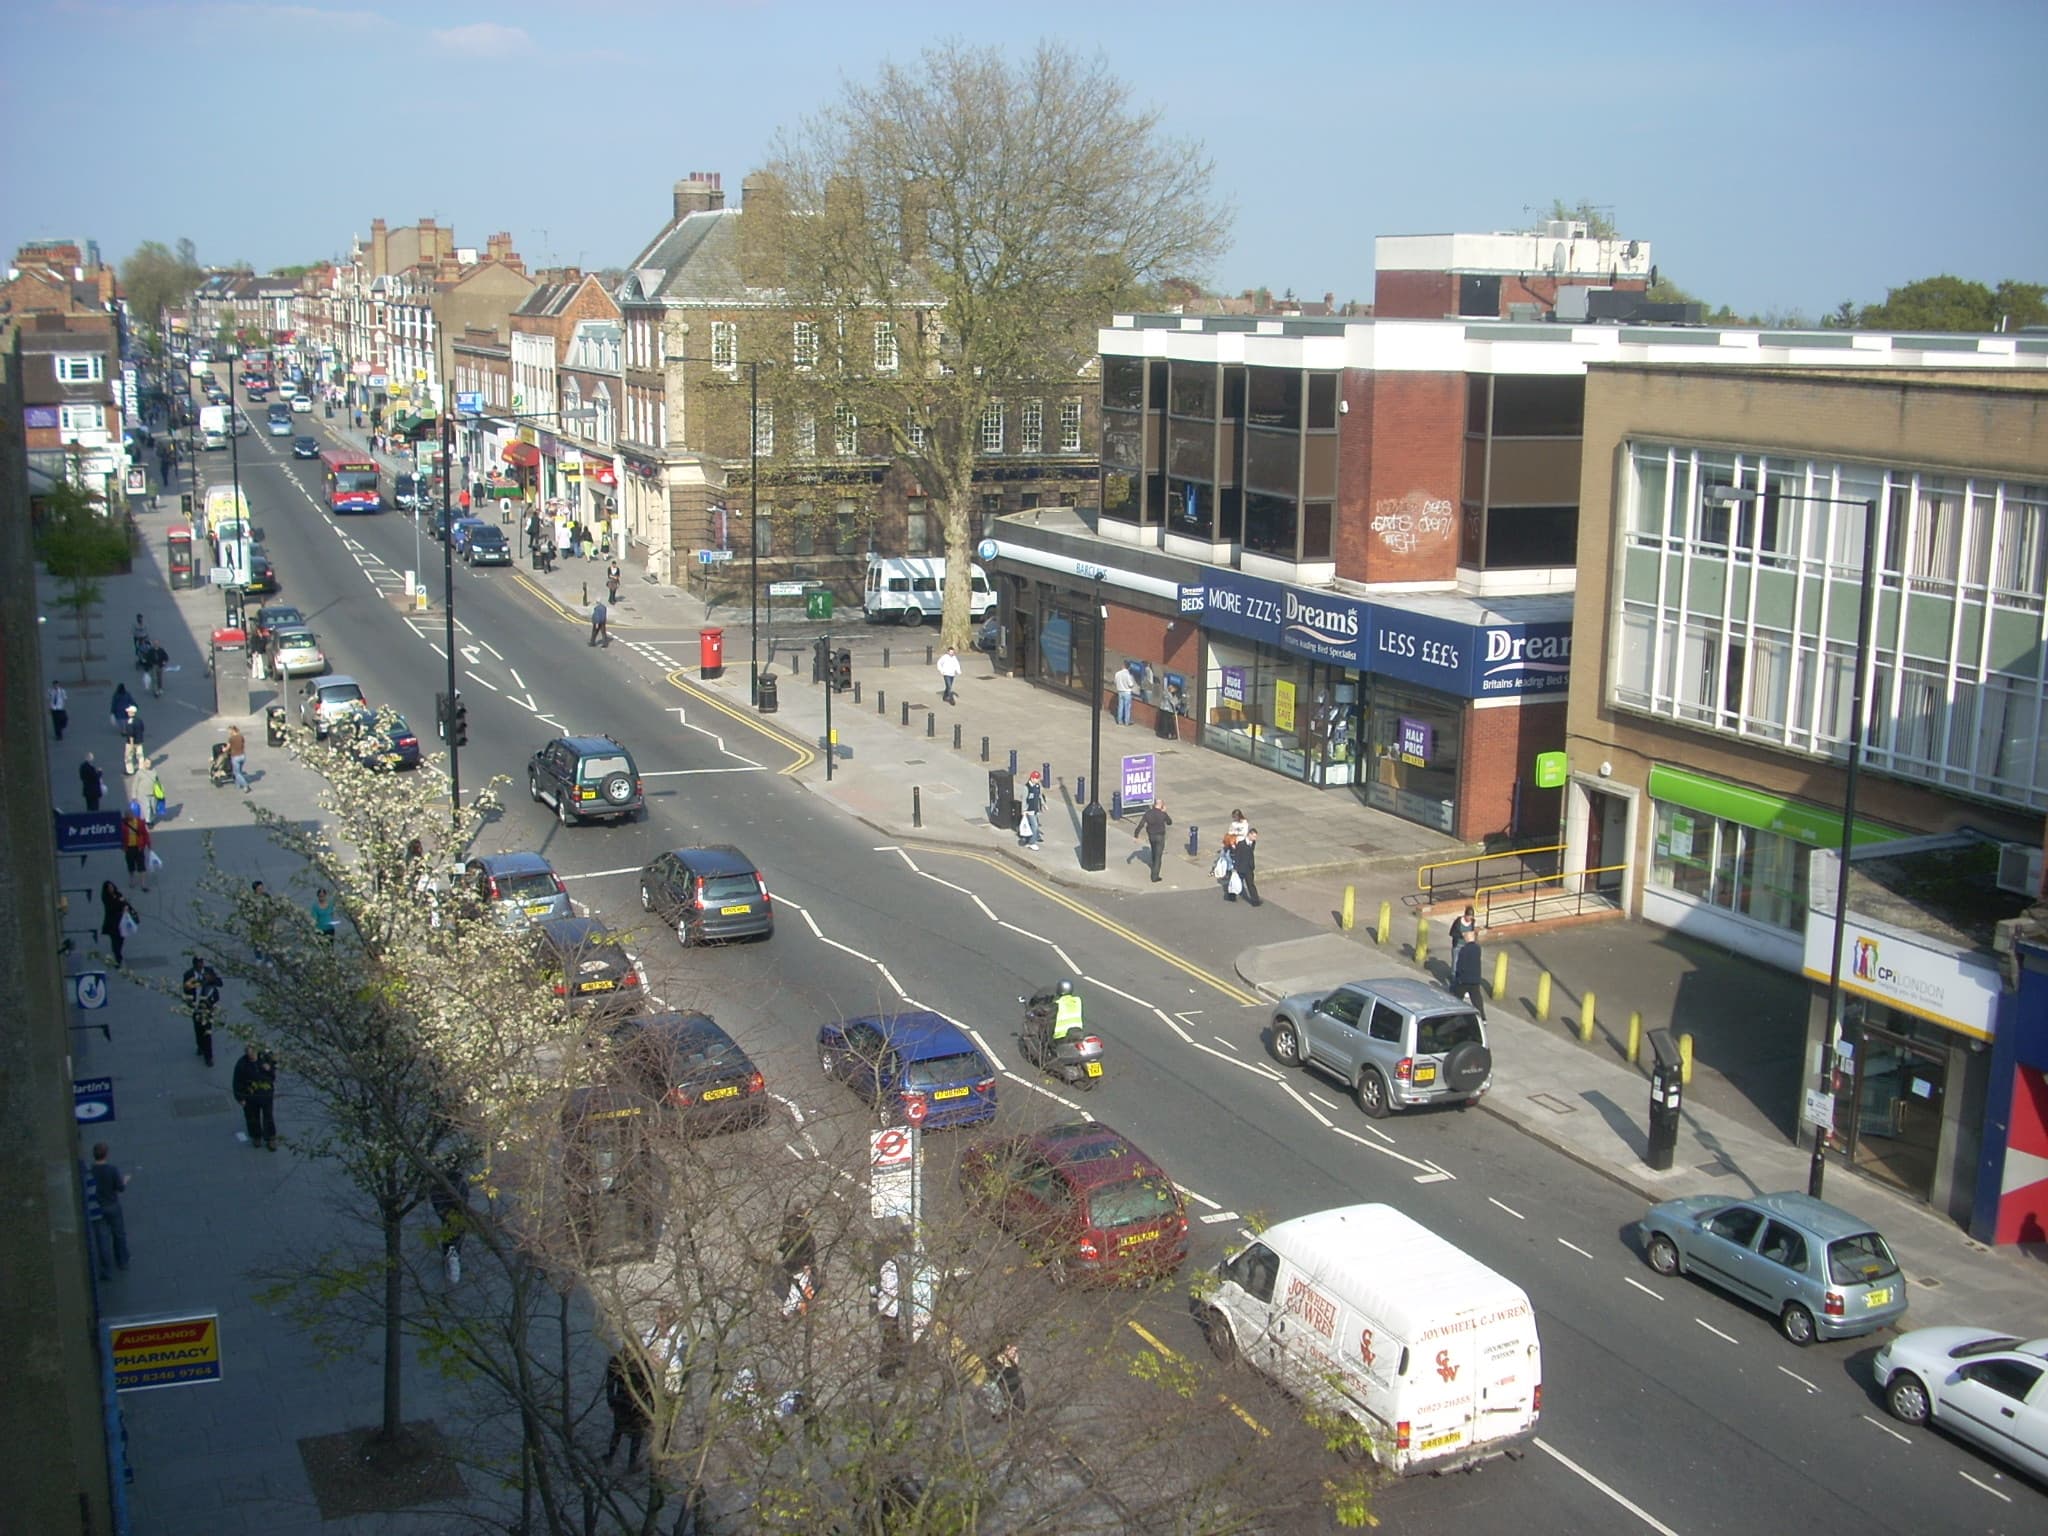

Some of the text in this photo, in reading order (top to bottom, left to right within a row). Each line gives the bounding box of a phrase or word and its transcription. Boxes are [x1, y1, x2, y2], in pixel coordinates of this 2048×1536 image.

[1181, 597, 1205, 611] BEDS
[1208, 587, 1242, 614] MORE
[1379, 629, 1416, 658] LESS
[1405, 728, 1424, 744] HALF
[1404, 740, 1424, 757] PRICE
[1126, 771, 1151, 785] HALF
[1125, 782, 1153, 796] PRICE
[122, 1328, 198, 1345] AUCKLANDS
[114, 1346, 210, 1366] PHARMACY
